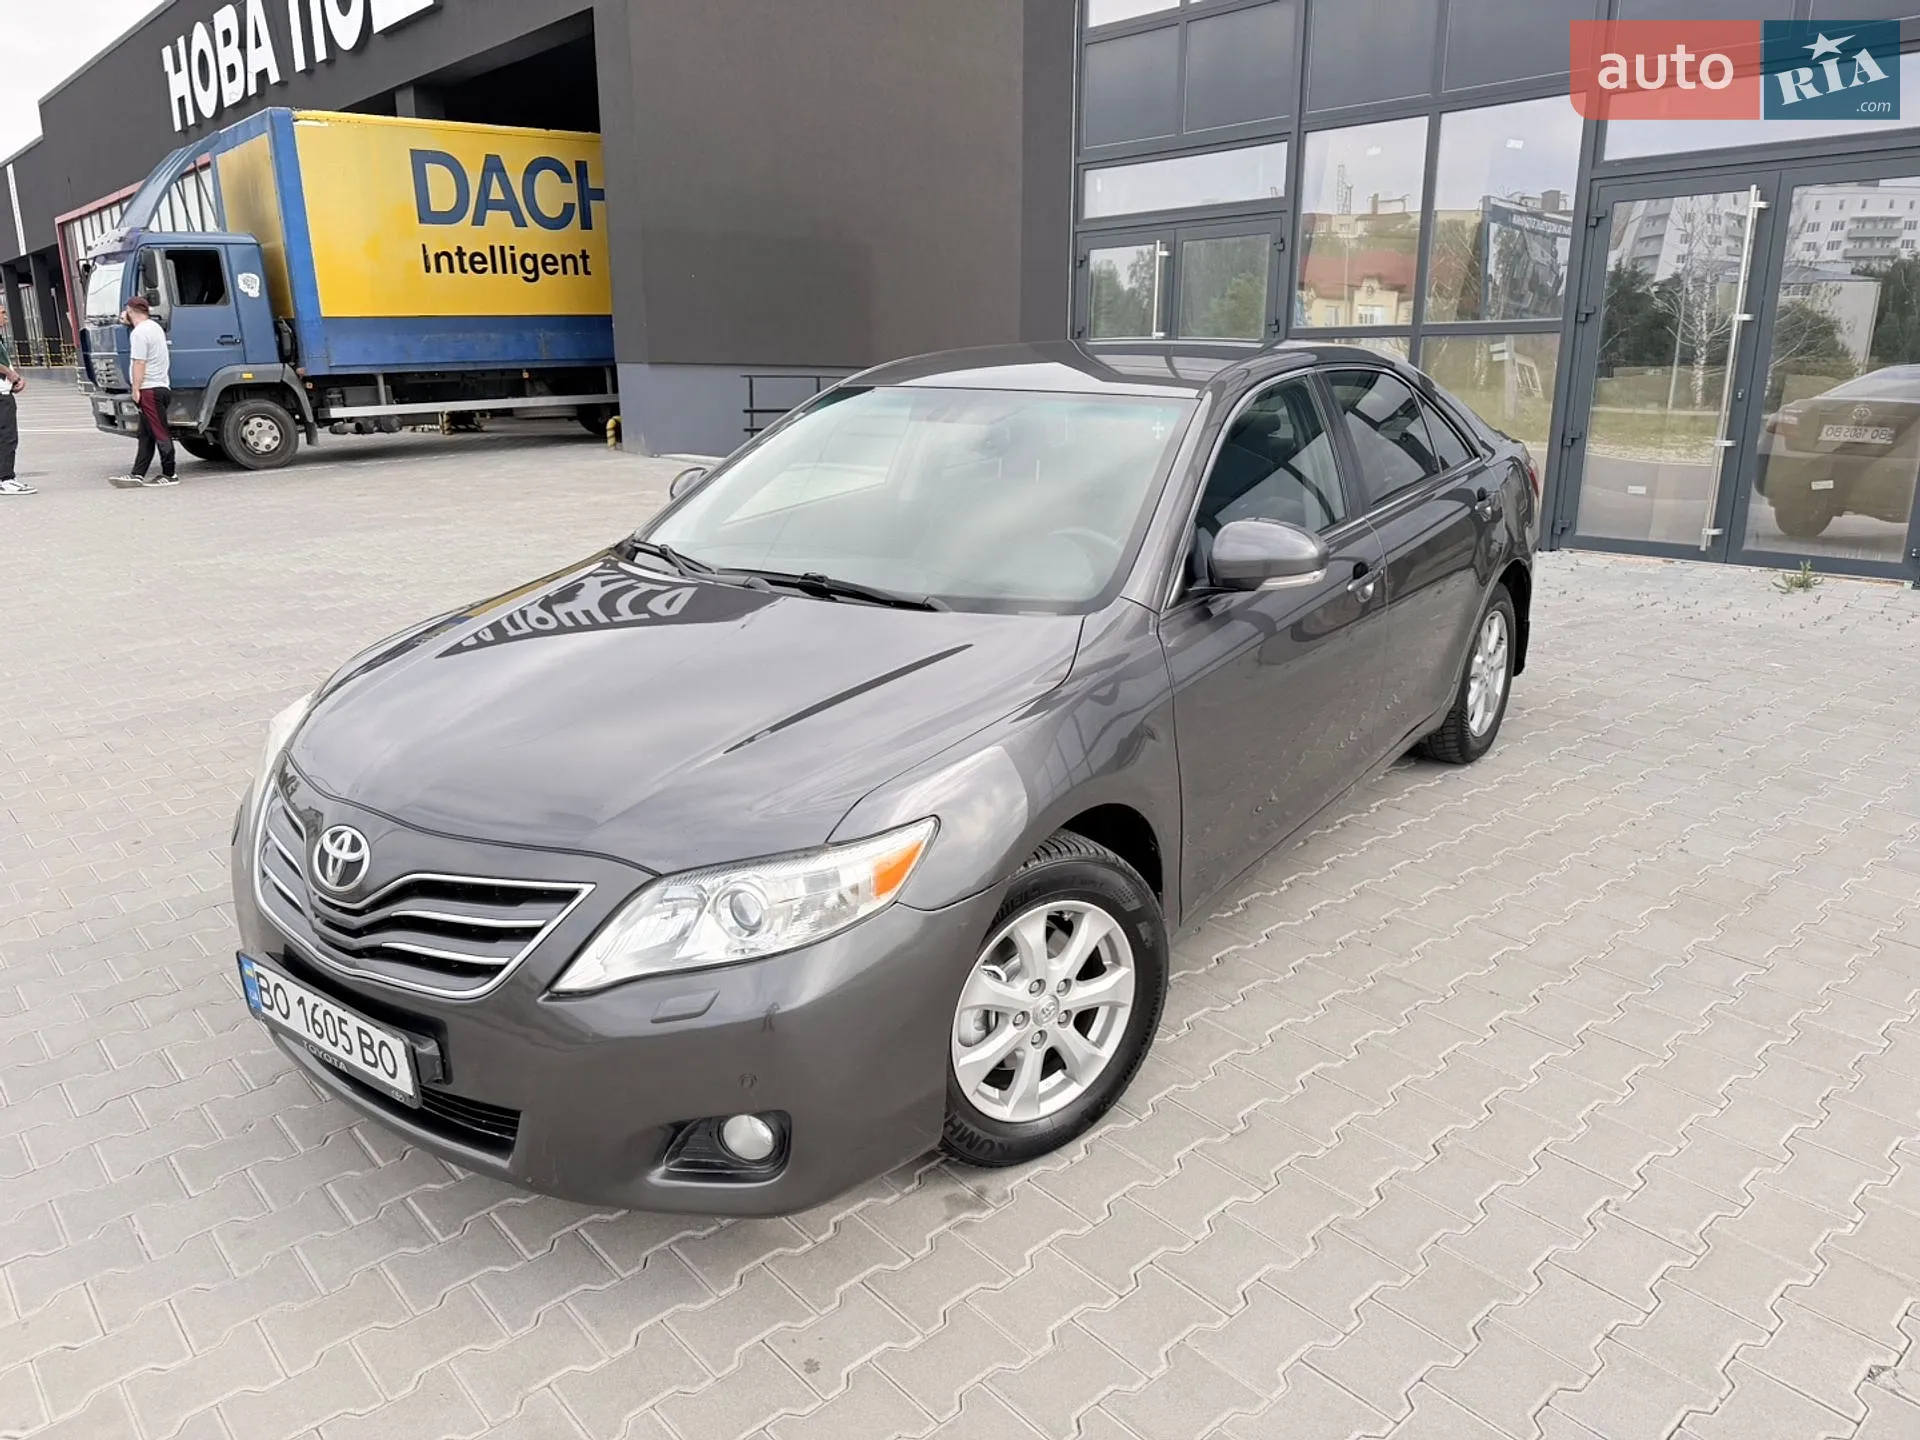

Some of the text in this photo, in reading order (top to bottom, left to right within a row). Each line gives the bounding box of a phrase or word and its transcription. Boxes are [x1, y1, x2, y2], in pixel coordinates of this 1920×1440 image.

[161, 0, 281, 132] НОВА
[421, 243, 592, 283] Intelligent
[255, 971, 398, 1080] BO 1605 BO
[303, 1040, 348, 1073] TOYOTA
[944, 1110, 1012, 1155] KUMH
